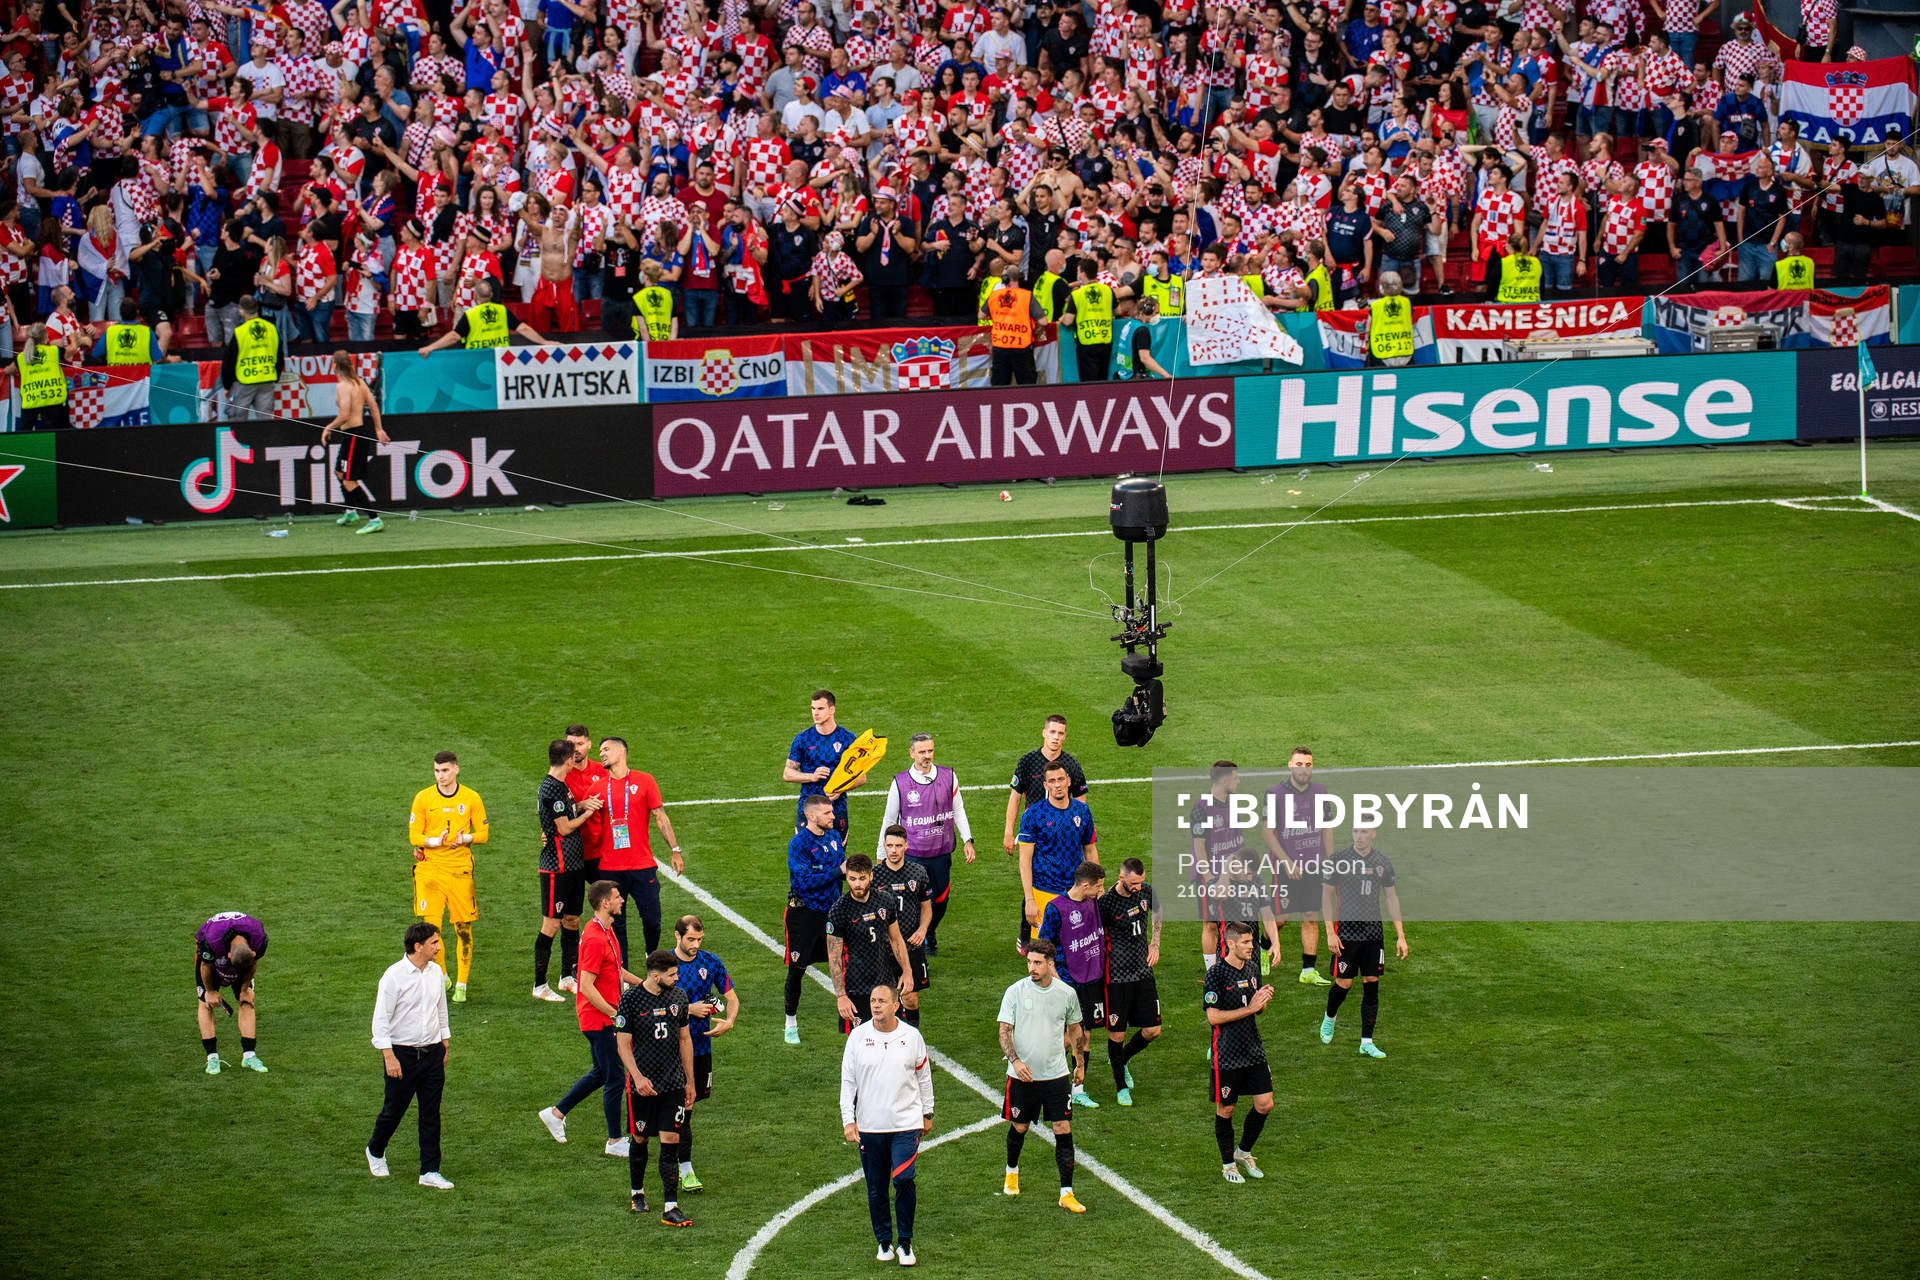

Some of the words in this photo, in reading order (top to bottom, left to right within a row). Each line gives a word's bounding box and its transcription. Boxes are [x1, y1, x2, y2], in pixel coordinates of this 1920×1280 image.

[1446, 301, 1629, 332] KAMEŠNICA
[470, 337, 510, 348] STEWAR
[284, 356, 336, 377] NOV
[654, 366, 694, 384] IZBI
[739, 358, 781, 381] ČNO
[504, 369, 631, 401] HRVATSKA
[1831, 370, 1920, 392] EQALGA
[1276, 373, 1753, 461] Hisense
[1892, 402, 1920, 416] RES
[657, 409, 905, 480] QATAR
[926, 392, 1232, 462] AIRWAYS
[869, 926, 877, 943] 5
[654, 1022, 669, 1040] 25
